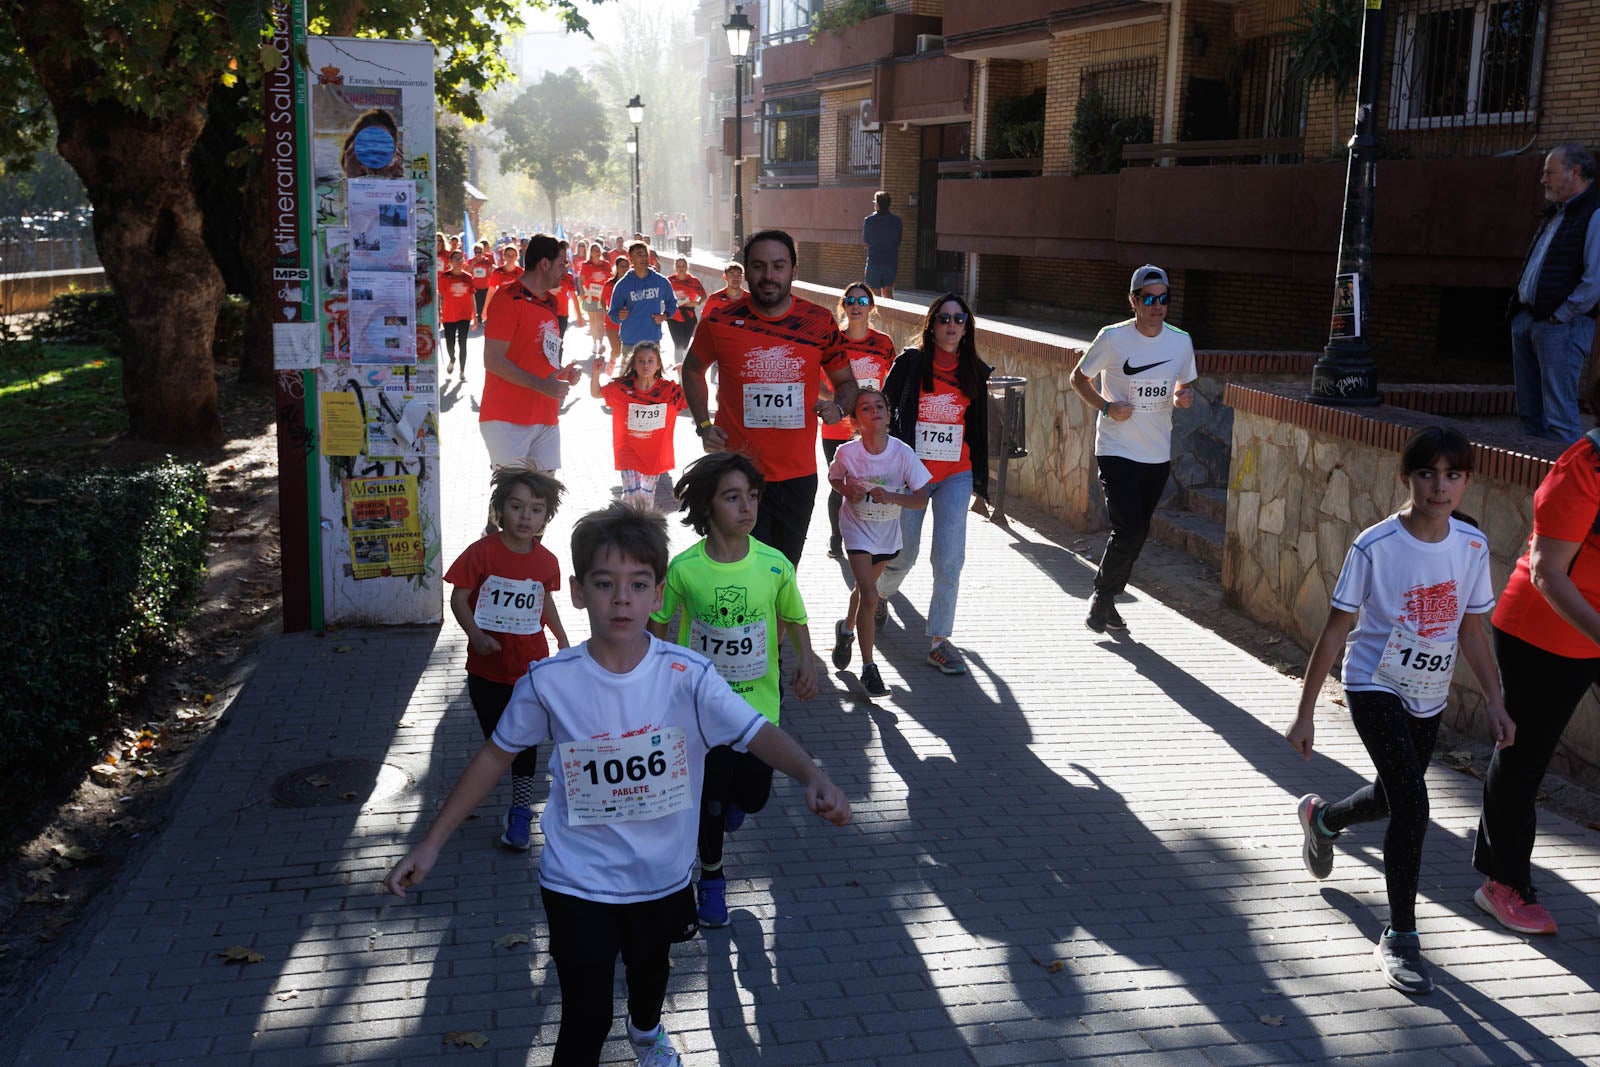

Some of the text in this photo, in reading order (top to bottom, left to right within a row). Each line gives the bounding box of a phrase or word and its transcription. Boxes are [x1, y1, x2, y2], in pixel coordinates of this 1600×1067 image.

[378, 77, 428, 88] Ayuntamiento
[275, 270, 308, 279] MPS
[630, 287, 660, 302] RUGBY
[746, 359, 801, 370] carrera
[1137, 386, 1167, 397] 1898
[753, 393, 793, 408] 1761
[634, 410, 660, 419] 1739
[919, 403, 960, 414] carrera
[921, 430, 953, 444] 1764
[354, 481, 406, 495] MOLINA
[390, 540, 422, 553] 149 €
[490, 589, 535, 609] 1760
[700, 634, 753, 656] 1759
[1399, 647, 1452, 672] 1593
[583, 750, 667, 785] 1066
[612, 785, 650, 797] PABLETE
